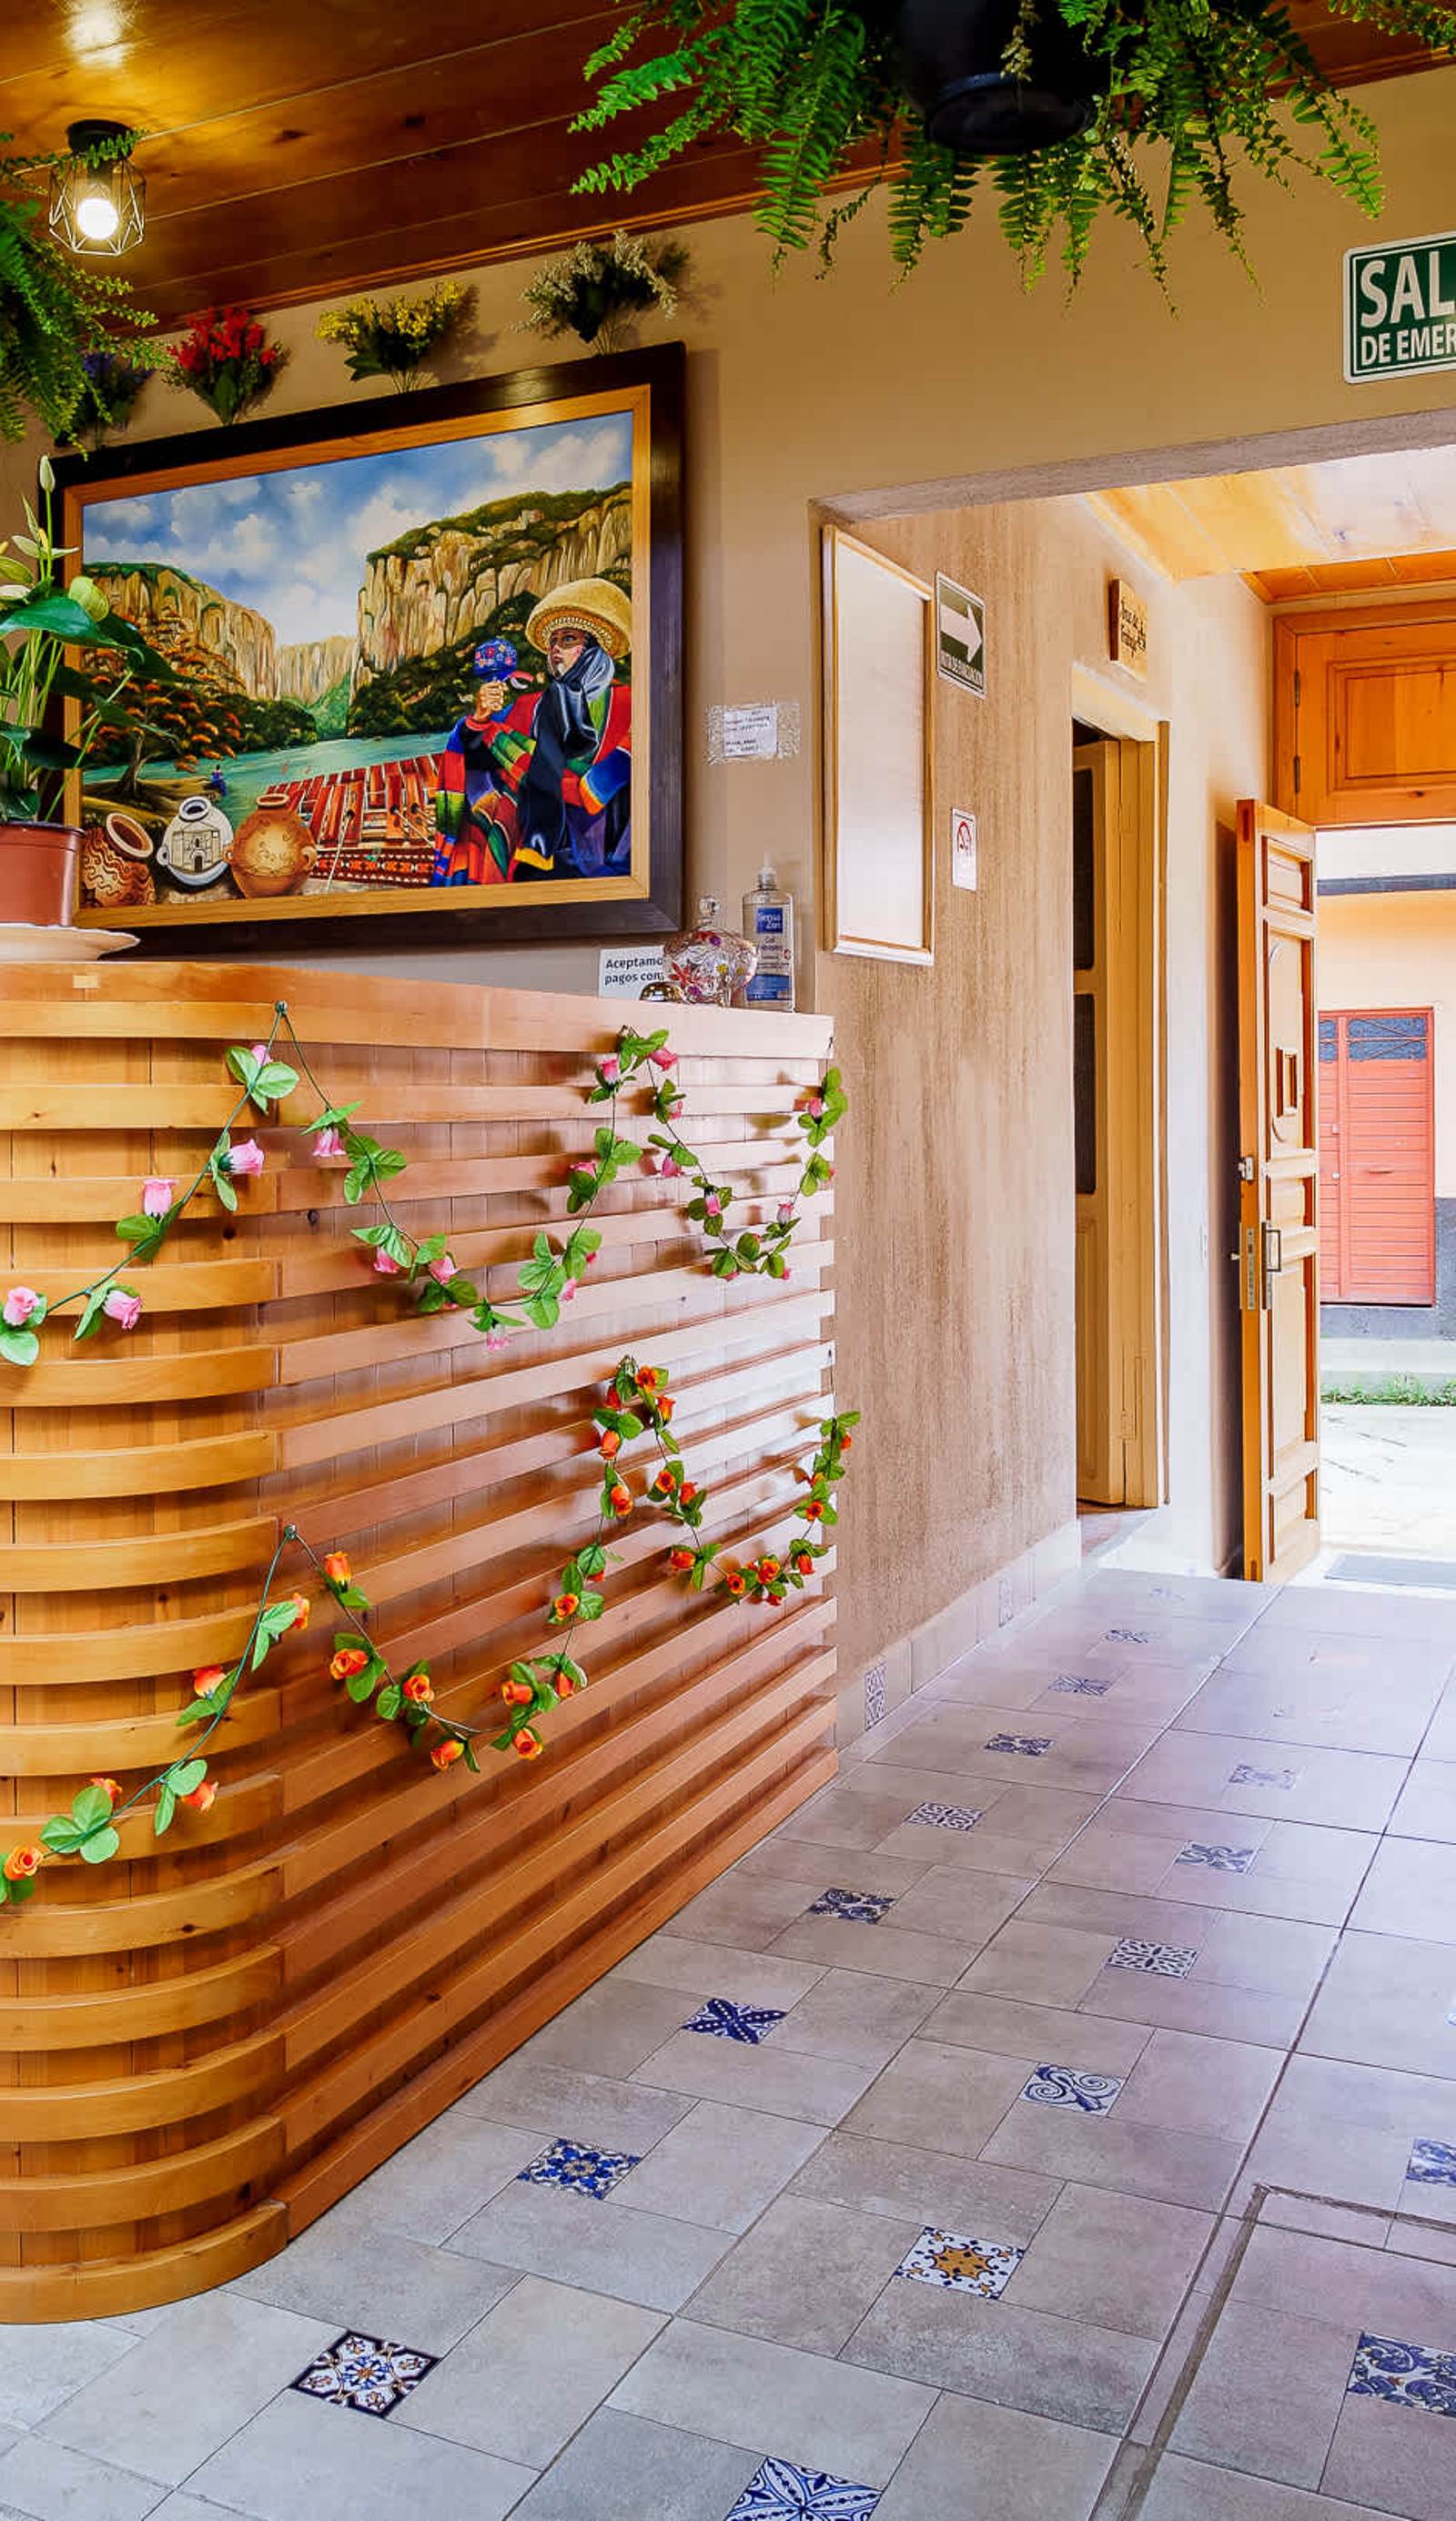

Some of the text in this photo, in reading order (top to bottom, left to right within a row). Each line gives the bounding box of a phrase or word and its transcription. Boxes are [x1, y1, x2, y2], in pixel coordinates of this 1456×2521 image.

[1360, 250, 1456, 329] SAL
[1360, 322, 1456, 366] DE EMER
[605, 957, 663, 970] Aceptamo
[604, 973, 639, 986] pagos
